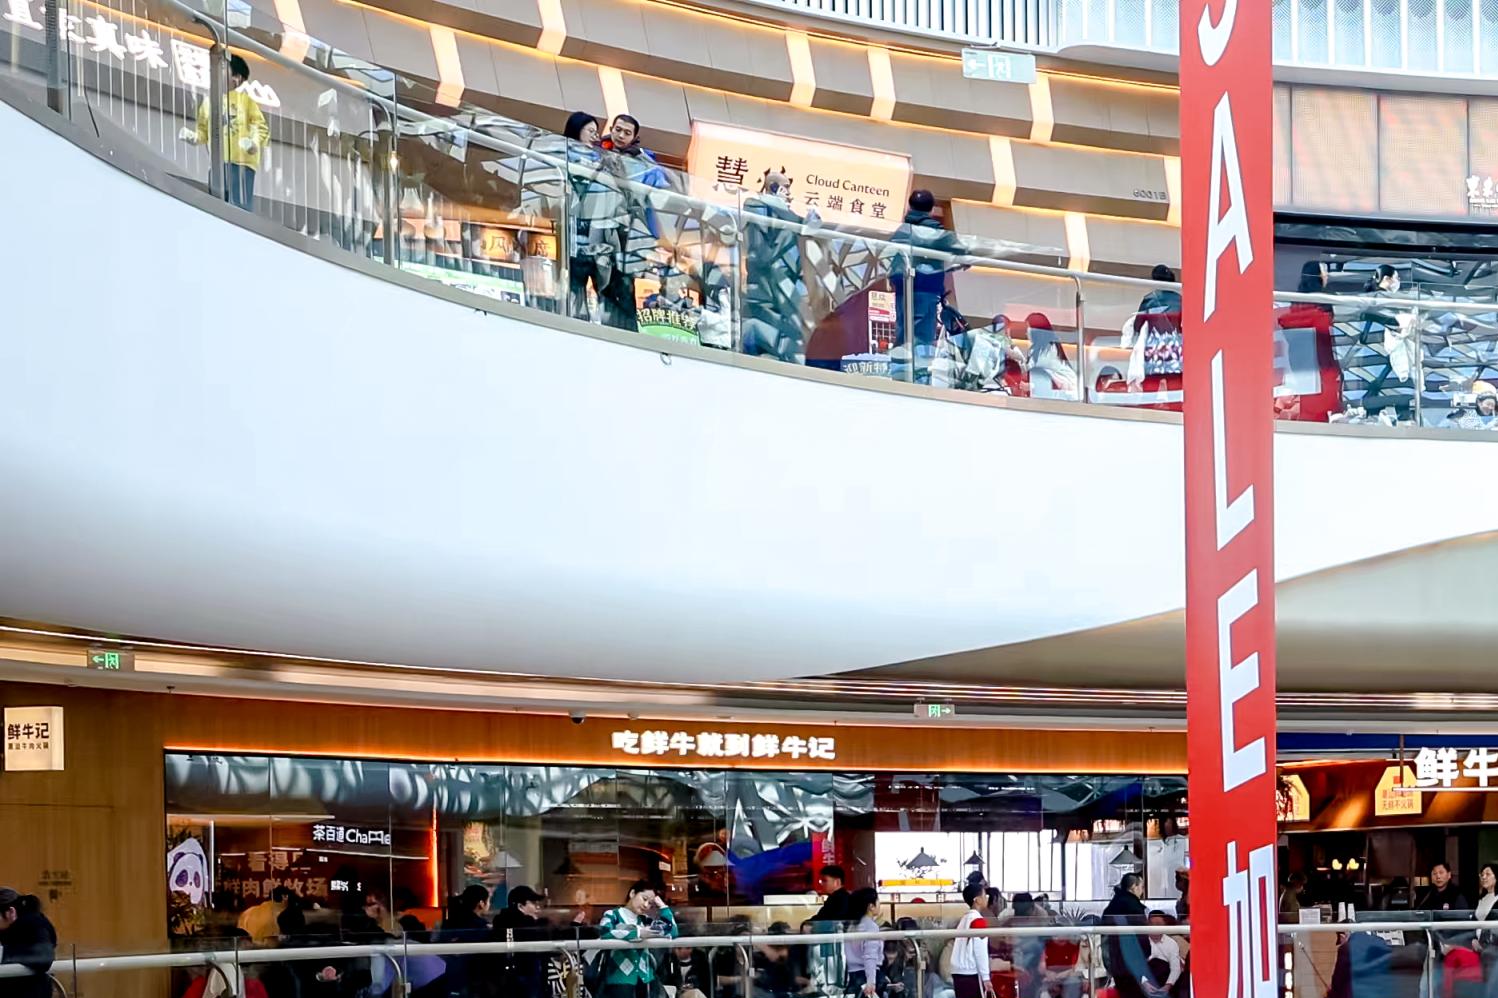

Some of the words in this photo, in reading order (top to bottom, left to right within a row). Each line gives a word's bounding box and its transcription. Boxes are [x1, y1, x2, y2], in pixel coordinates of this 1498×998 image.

[806, 174, 840, 189] Cloud
[842, 180, 890, 198] Canteen
[804, 192, 887, 219] 云端食堂
[8, 723, 49, 740] 鲜牛记
[612, 730, 836, 759] 吃鲜牛就到鲜牛记
[313, 825, 344, 842] 茶百道
